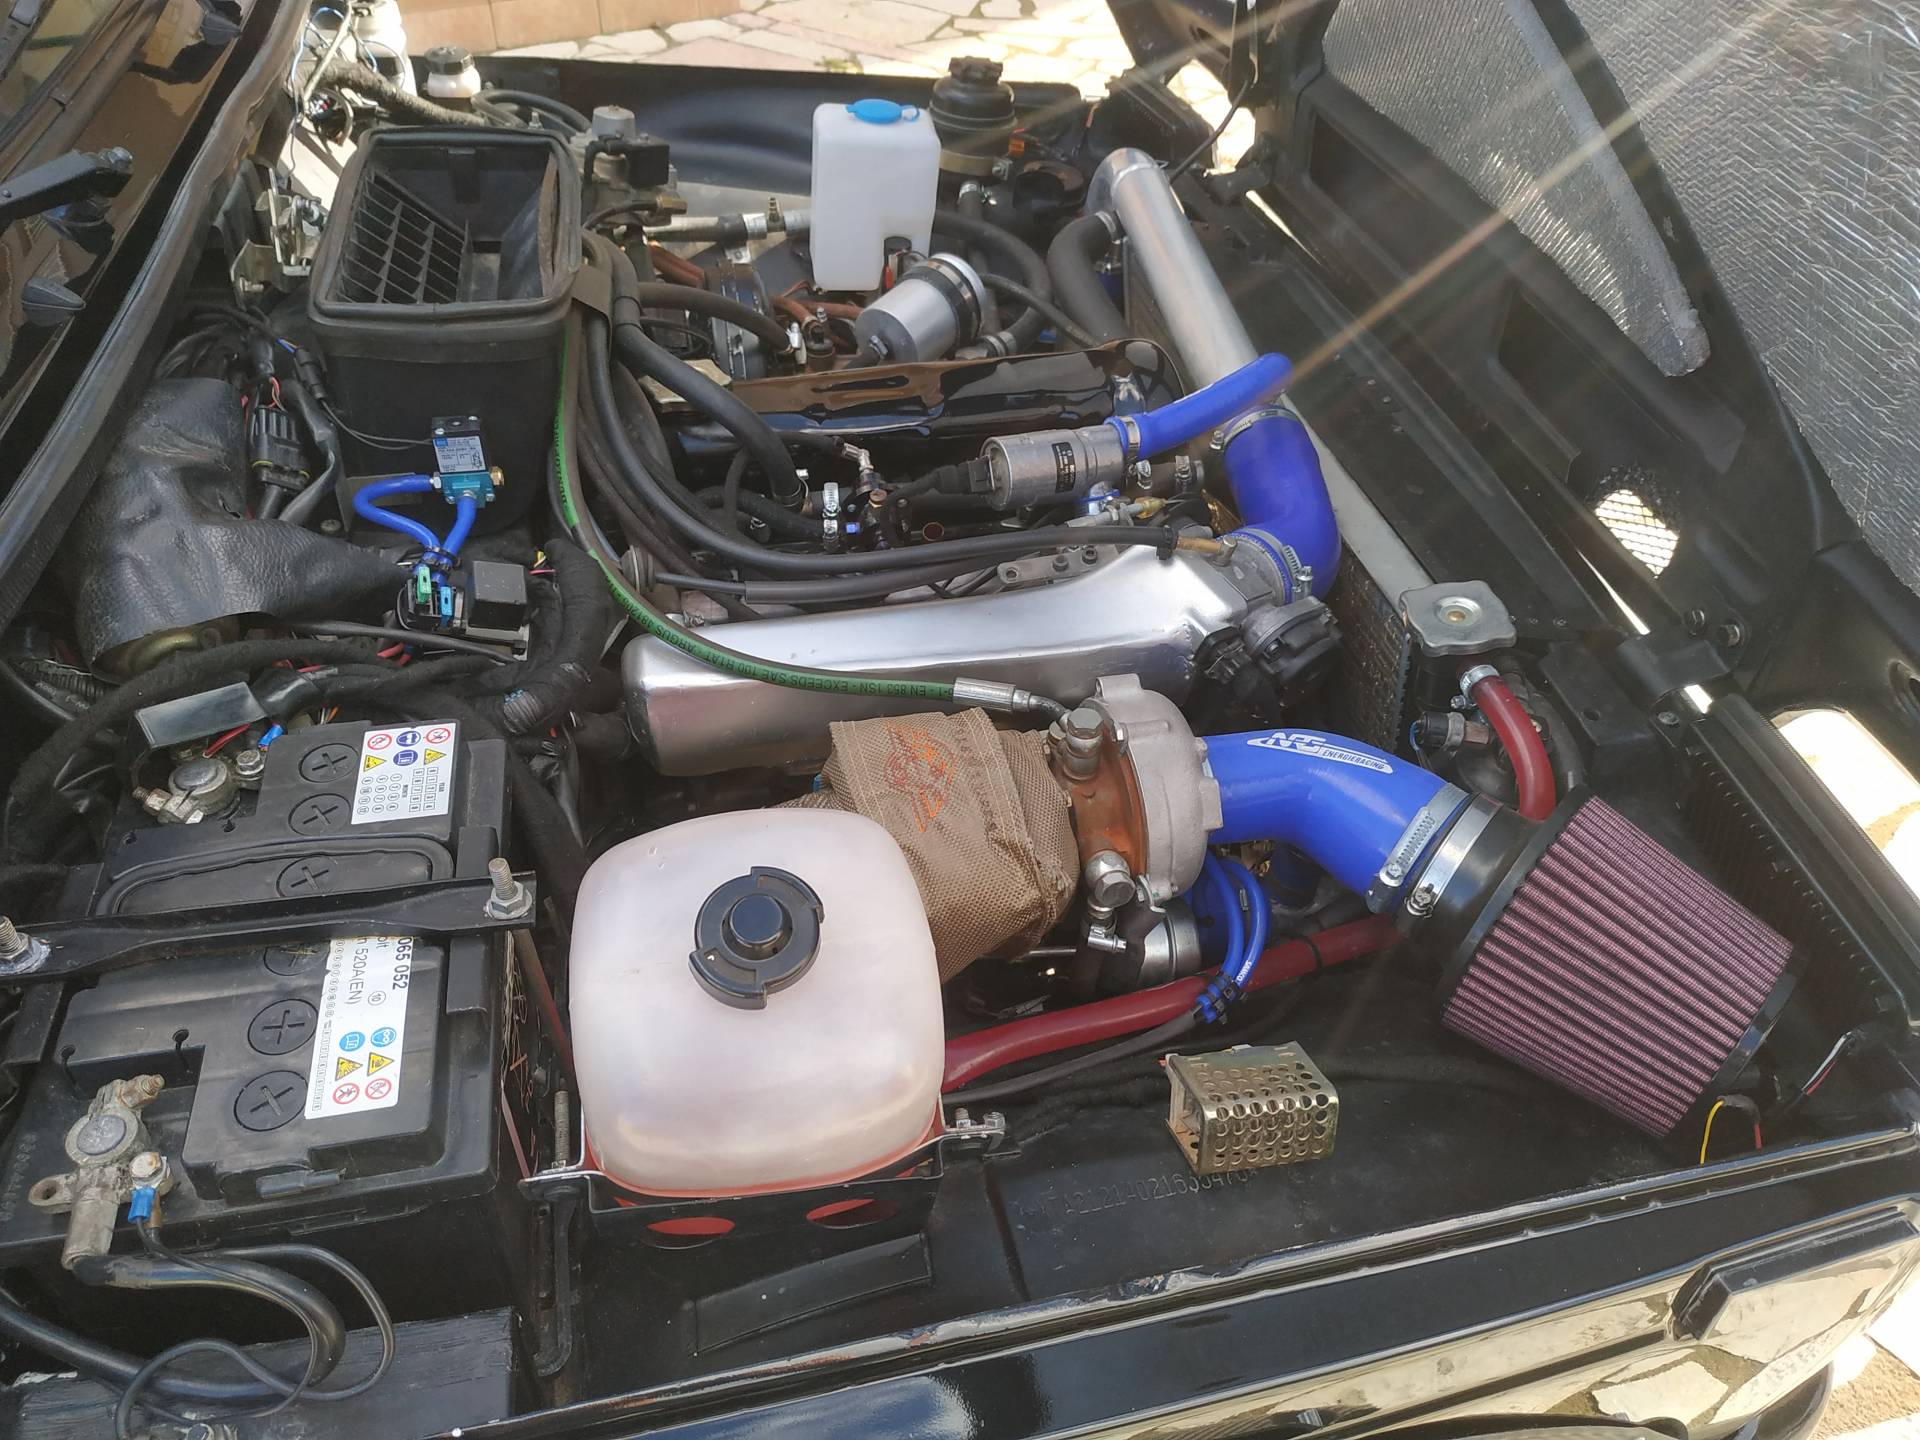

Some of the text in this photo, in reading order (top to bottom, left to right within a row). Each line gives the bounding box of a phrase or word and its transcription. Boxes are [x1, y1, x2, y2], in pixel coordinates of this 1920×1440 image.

[655, 625, 696, 652] ARGUS
[738, 663, 757, 677] 100
[762, 669, 787, 684] SAE
[790, 674, 849, 692] EXCEEDS
[887, 683, 906, 695] 853
[910, 684, 926, 697] EN
[1322, 749, 1386, 770] ENERGIERACING
[392, 937, 412, 990] 065 052
